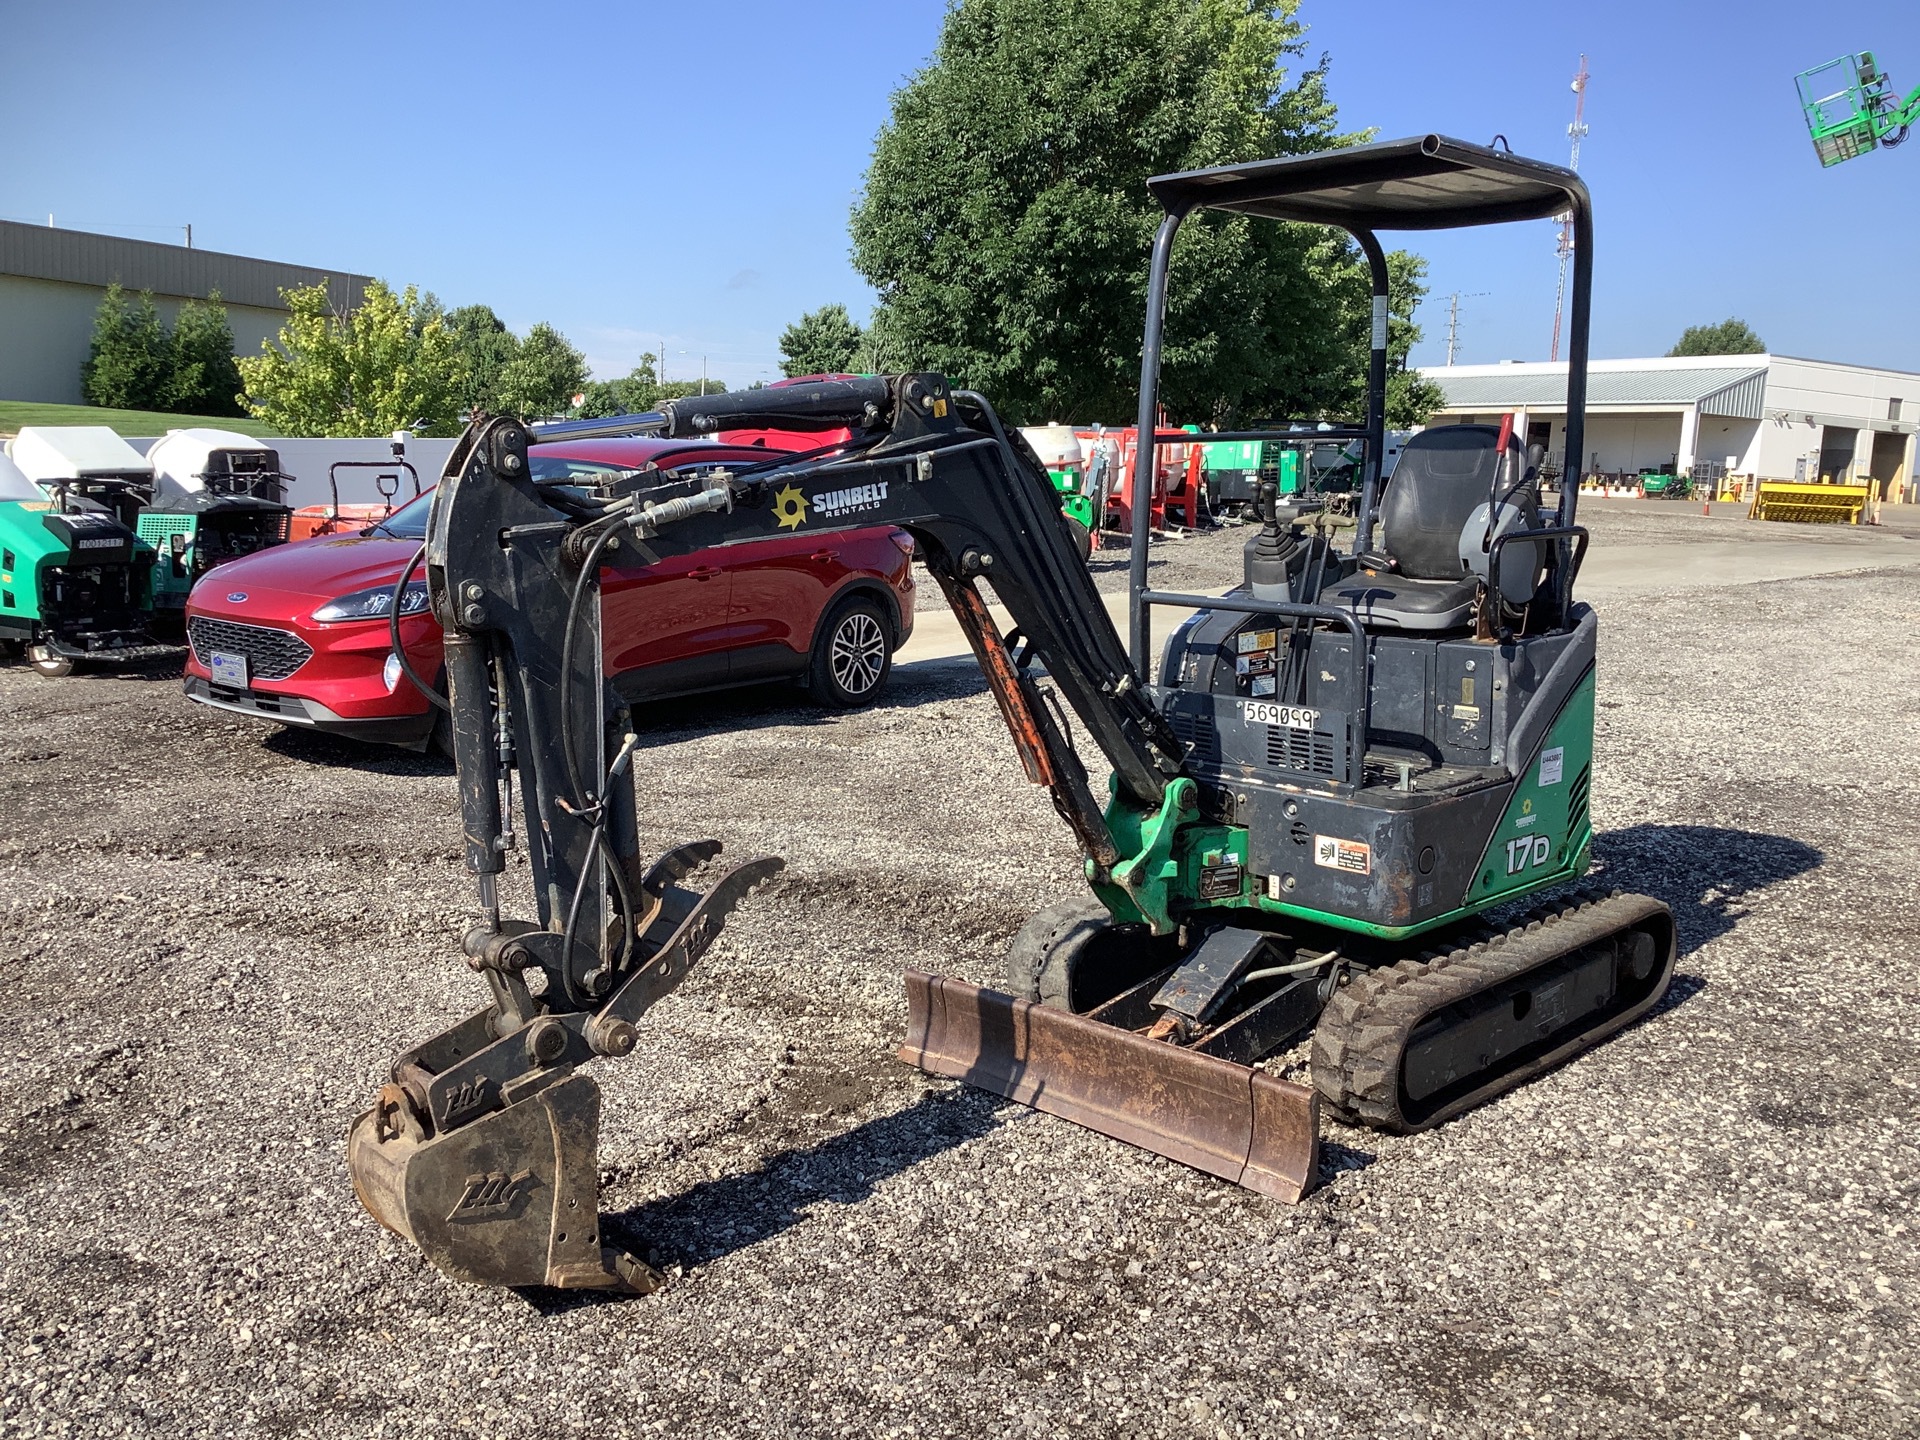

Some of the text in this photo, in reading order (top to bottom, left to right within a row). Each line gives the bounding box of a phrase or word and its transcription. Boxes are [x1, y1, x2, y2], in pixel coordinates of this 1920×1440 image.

[812, 481, 889, 513] SUNBELT
[825, 501, 881, 519] RENTALS
[1247, 703, 1313, 729] 569099
[1506, 833, 1551, 875] 17D
